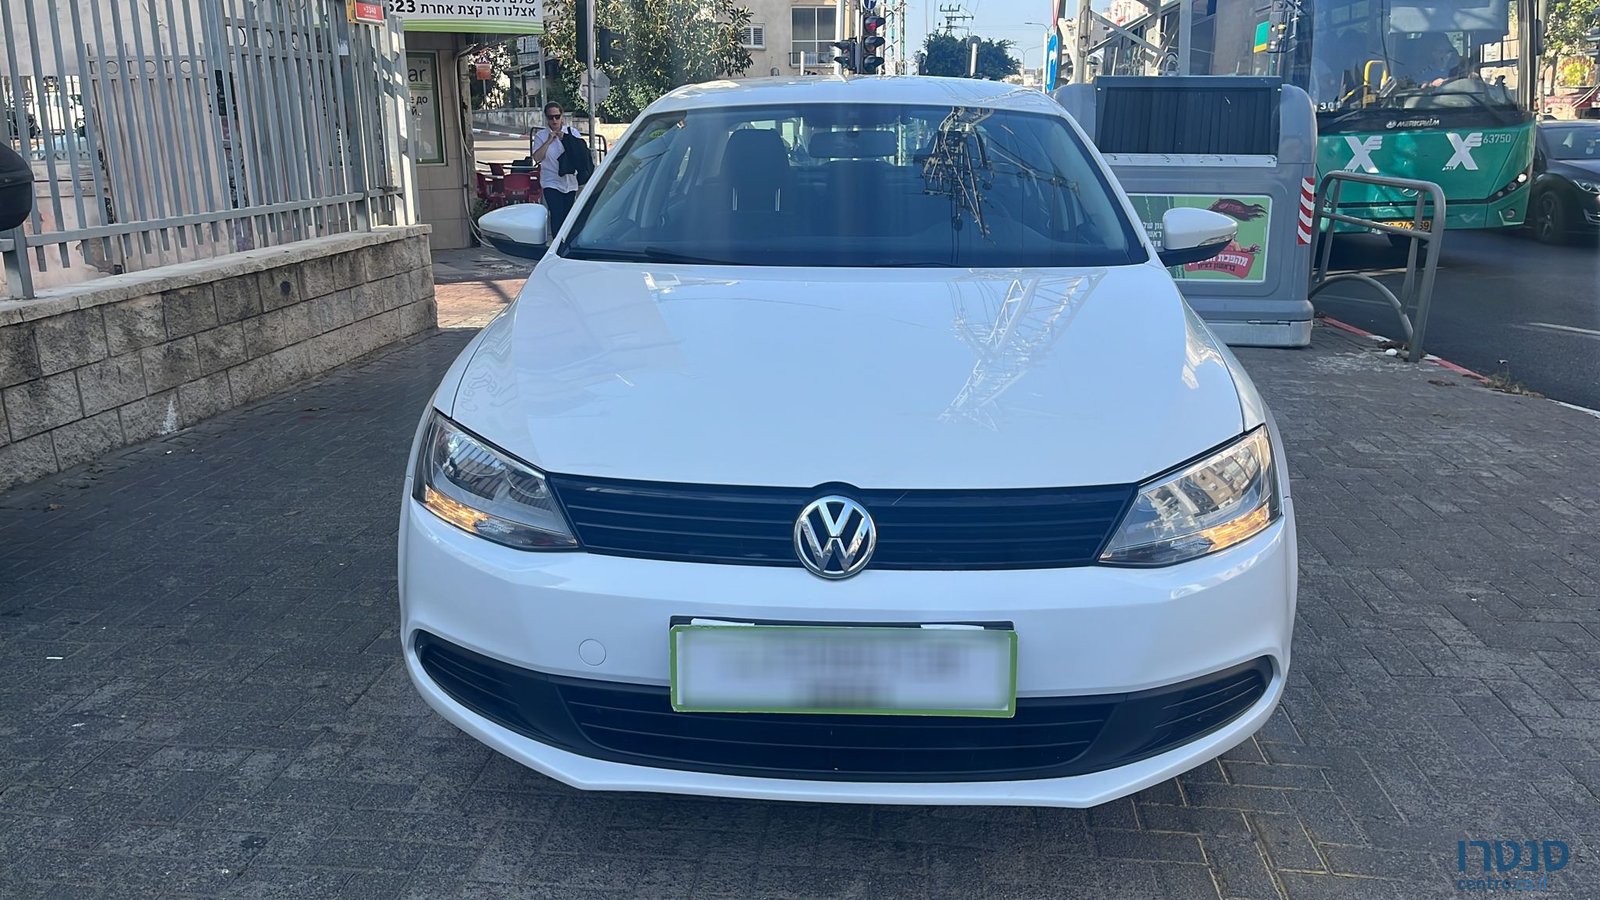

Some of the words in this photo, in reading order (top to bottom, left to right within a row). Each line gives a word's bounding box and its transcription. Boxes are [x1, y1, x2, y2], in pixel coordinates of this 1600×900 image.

[420, 3, 454, 14] אחרת
[458, 4, 483, 18] קצת
[487, 5, 500, 16] זה
[504, 5, 536, 17] אצלנו
[1483, 134, 1511, 144] 63750
